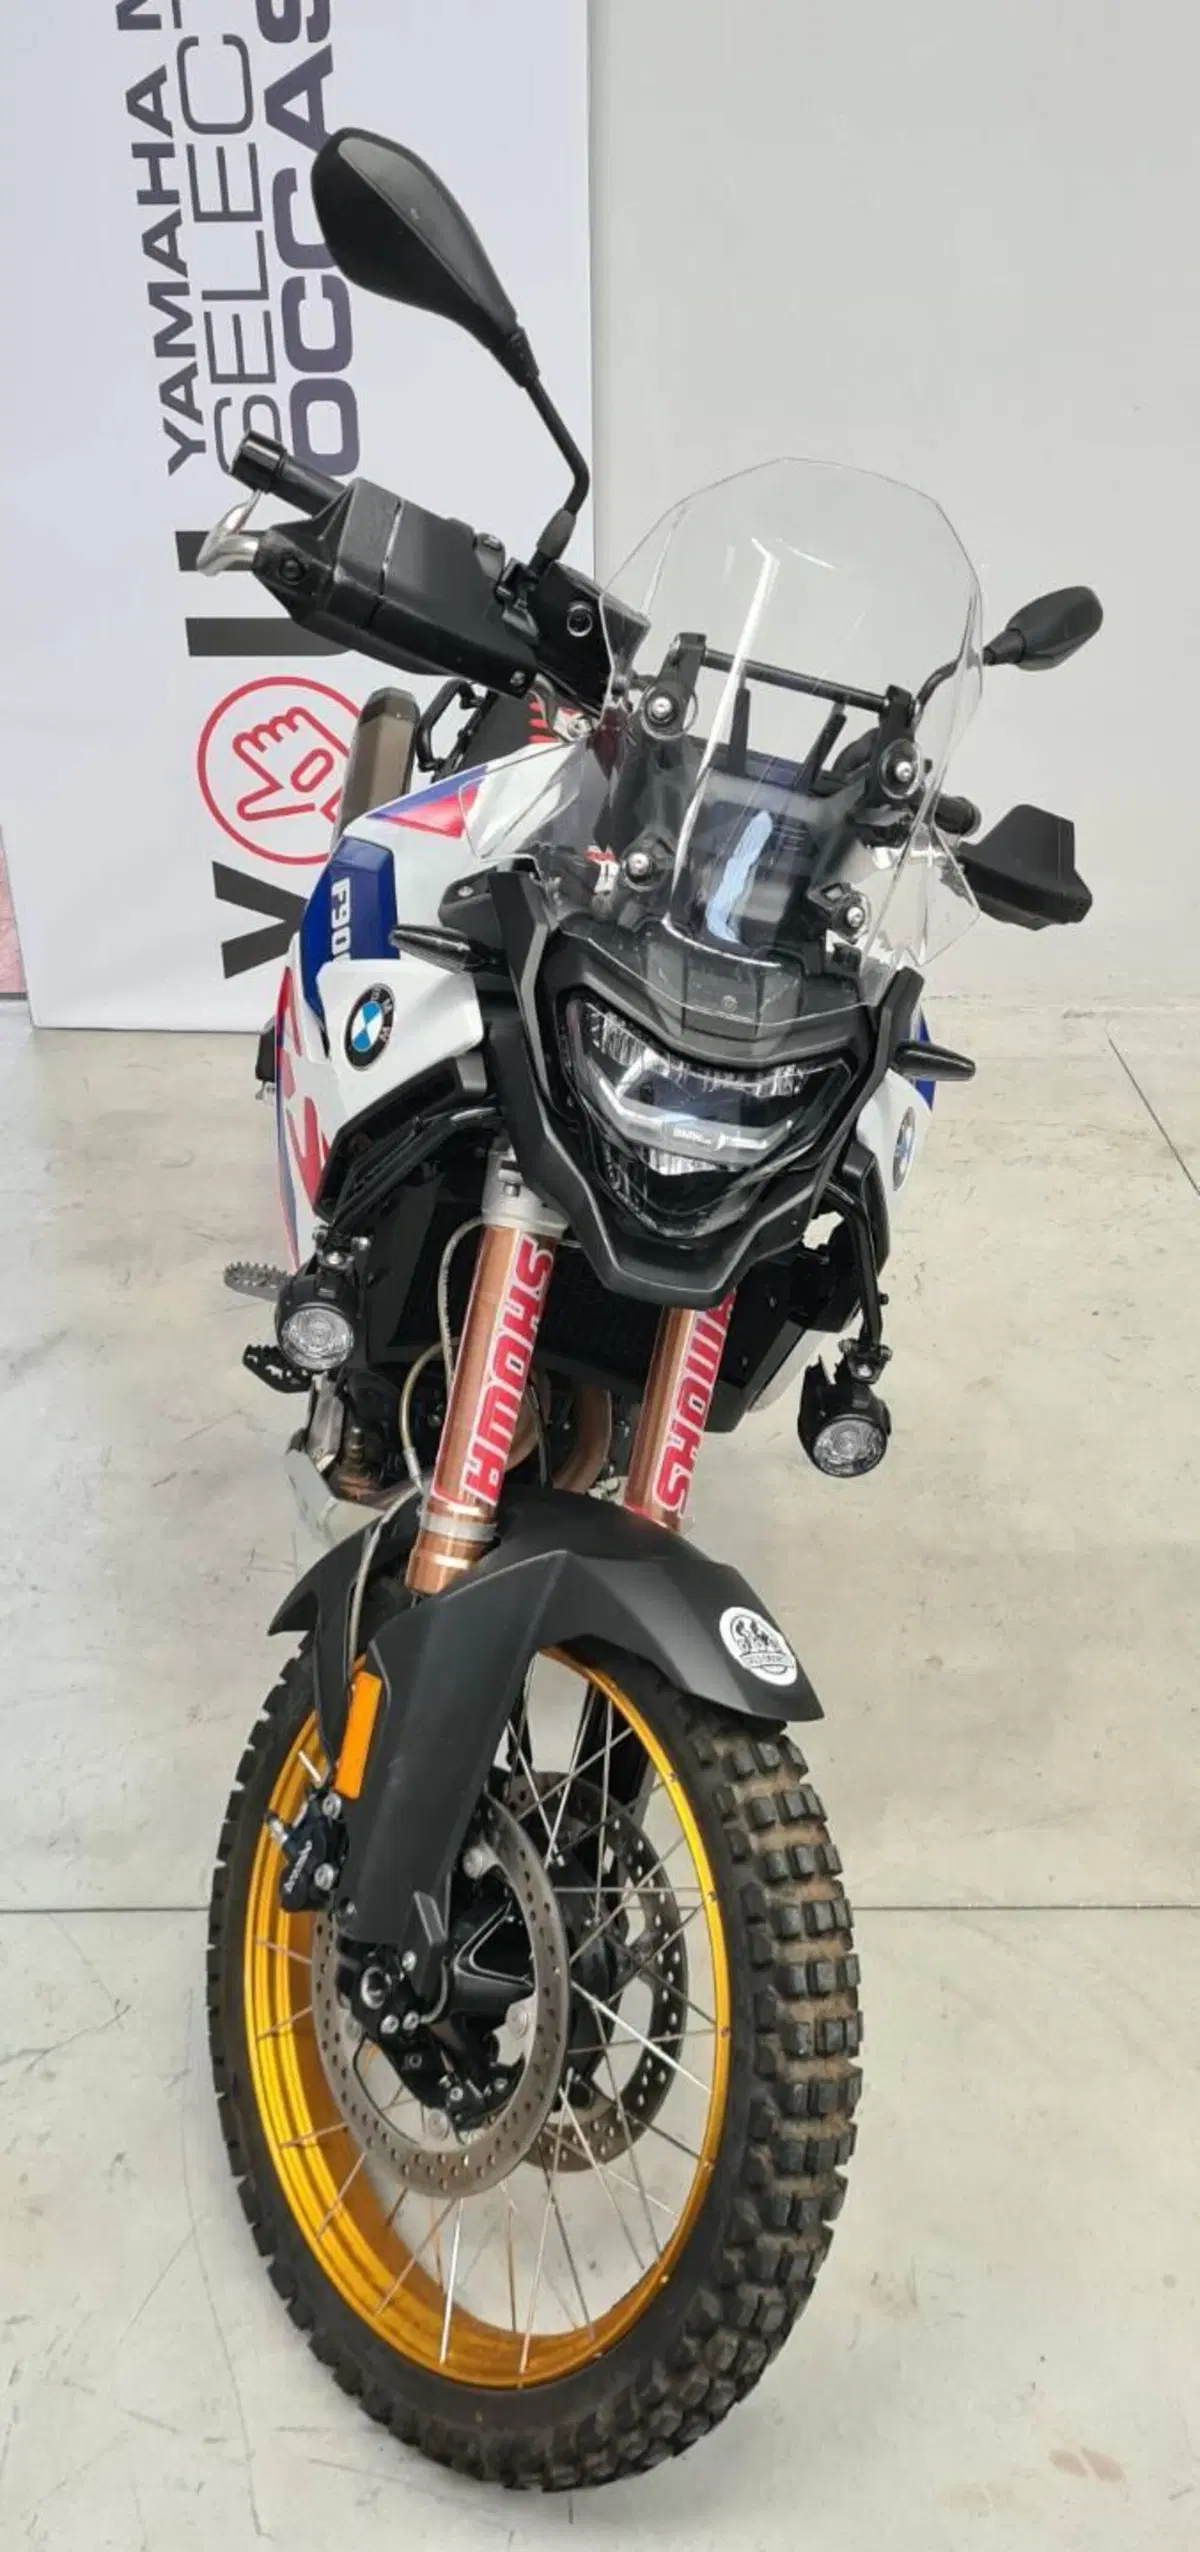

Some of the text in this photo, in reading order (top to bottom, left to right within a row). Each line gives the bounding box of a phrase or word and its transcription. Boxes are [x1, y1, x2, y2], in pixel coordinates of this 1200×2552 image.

[125, 64, 207, 476] YAMAHA
[331, 877, 351, 961] F90
[460, 1233, 554, 1506] SHOWA
